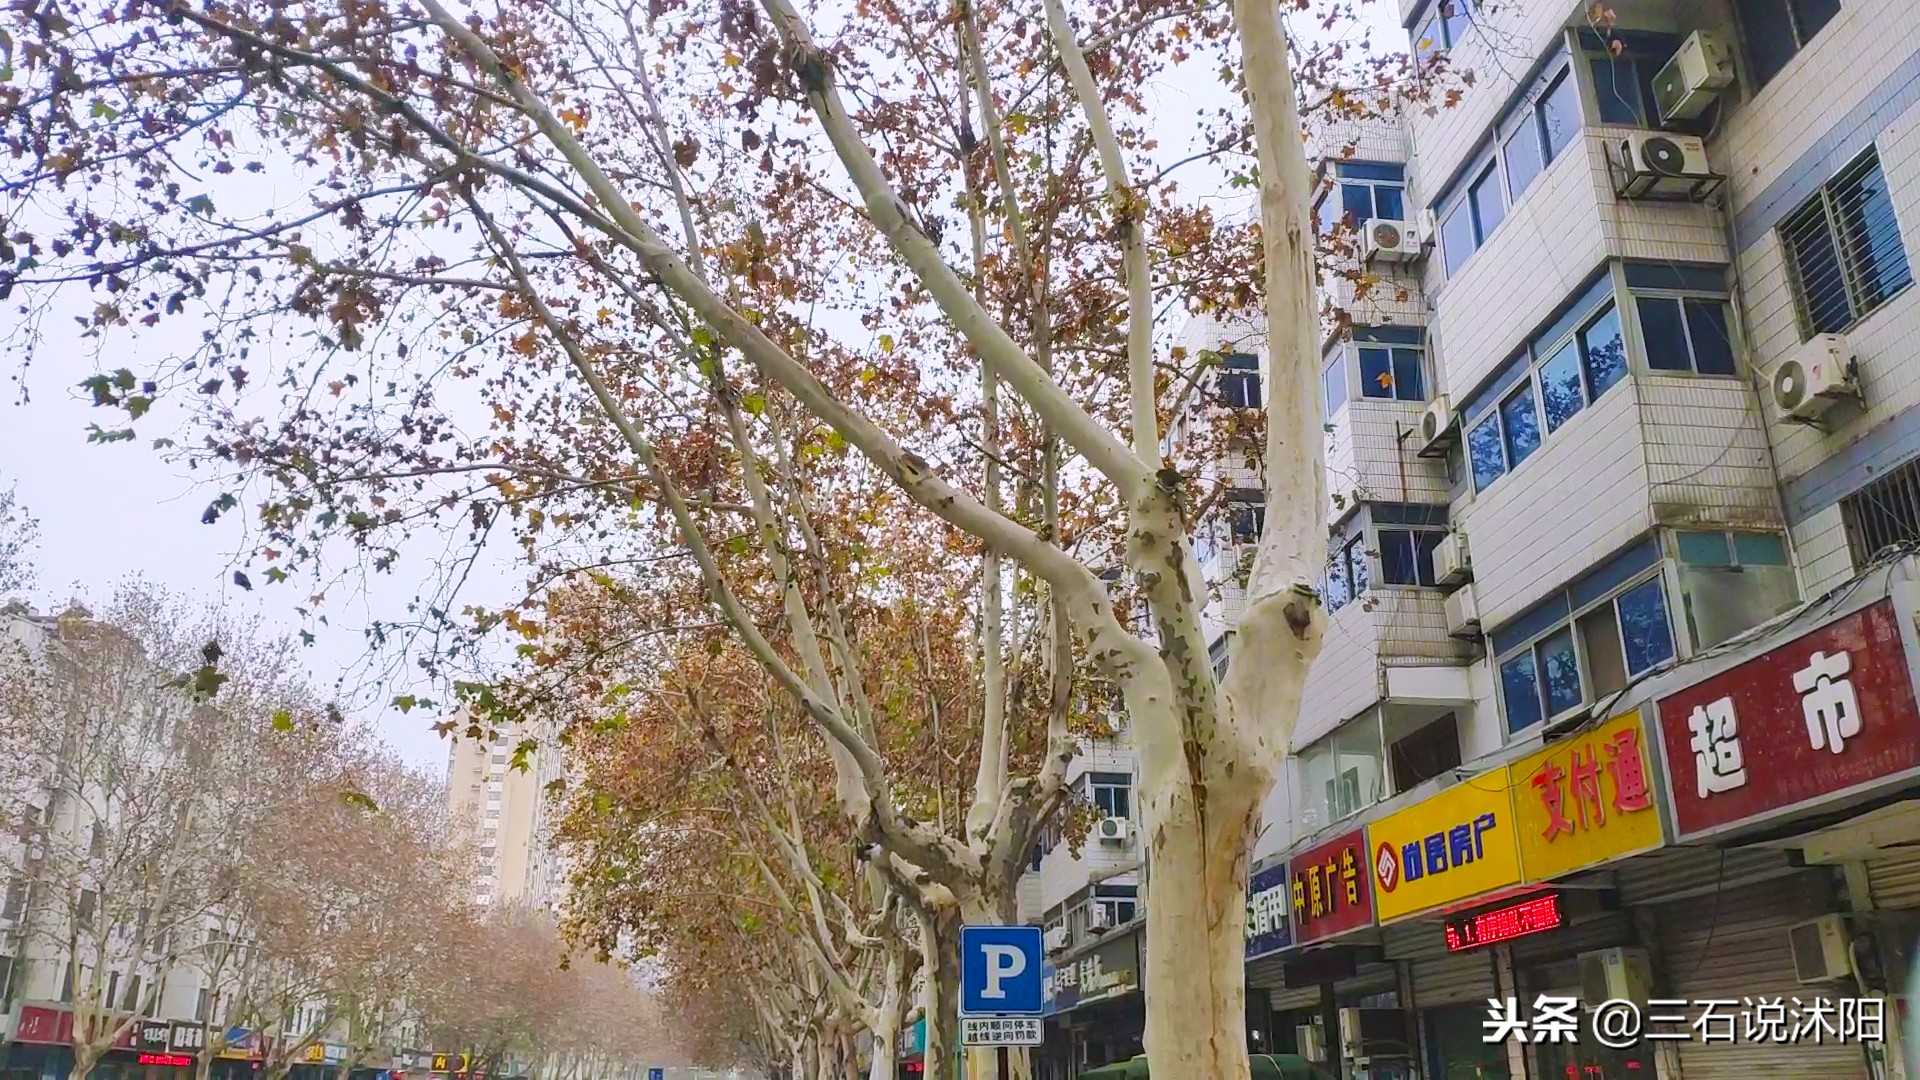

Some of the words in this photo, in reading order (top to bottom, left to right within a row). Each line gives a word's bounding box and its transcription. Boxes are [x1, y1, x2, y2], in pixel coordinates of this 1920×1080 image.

[1687, 650, 1862, 799] 超市
[1531, 727, 1652, 843] 支付通
[1293, 847, 1358, 925] 中原广告
[980, 944, 1027, 1000] P
